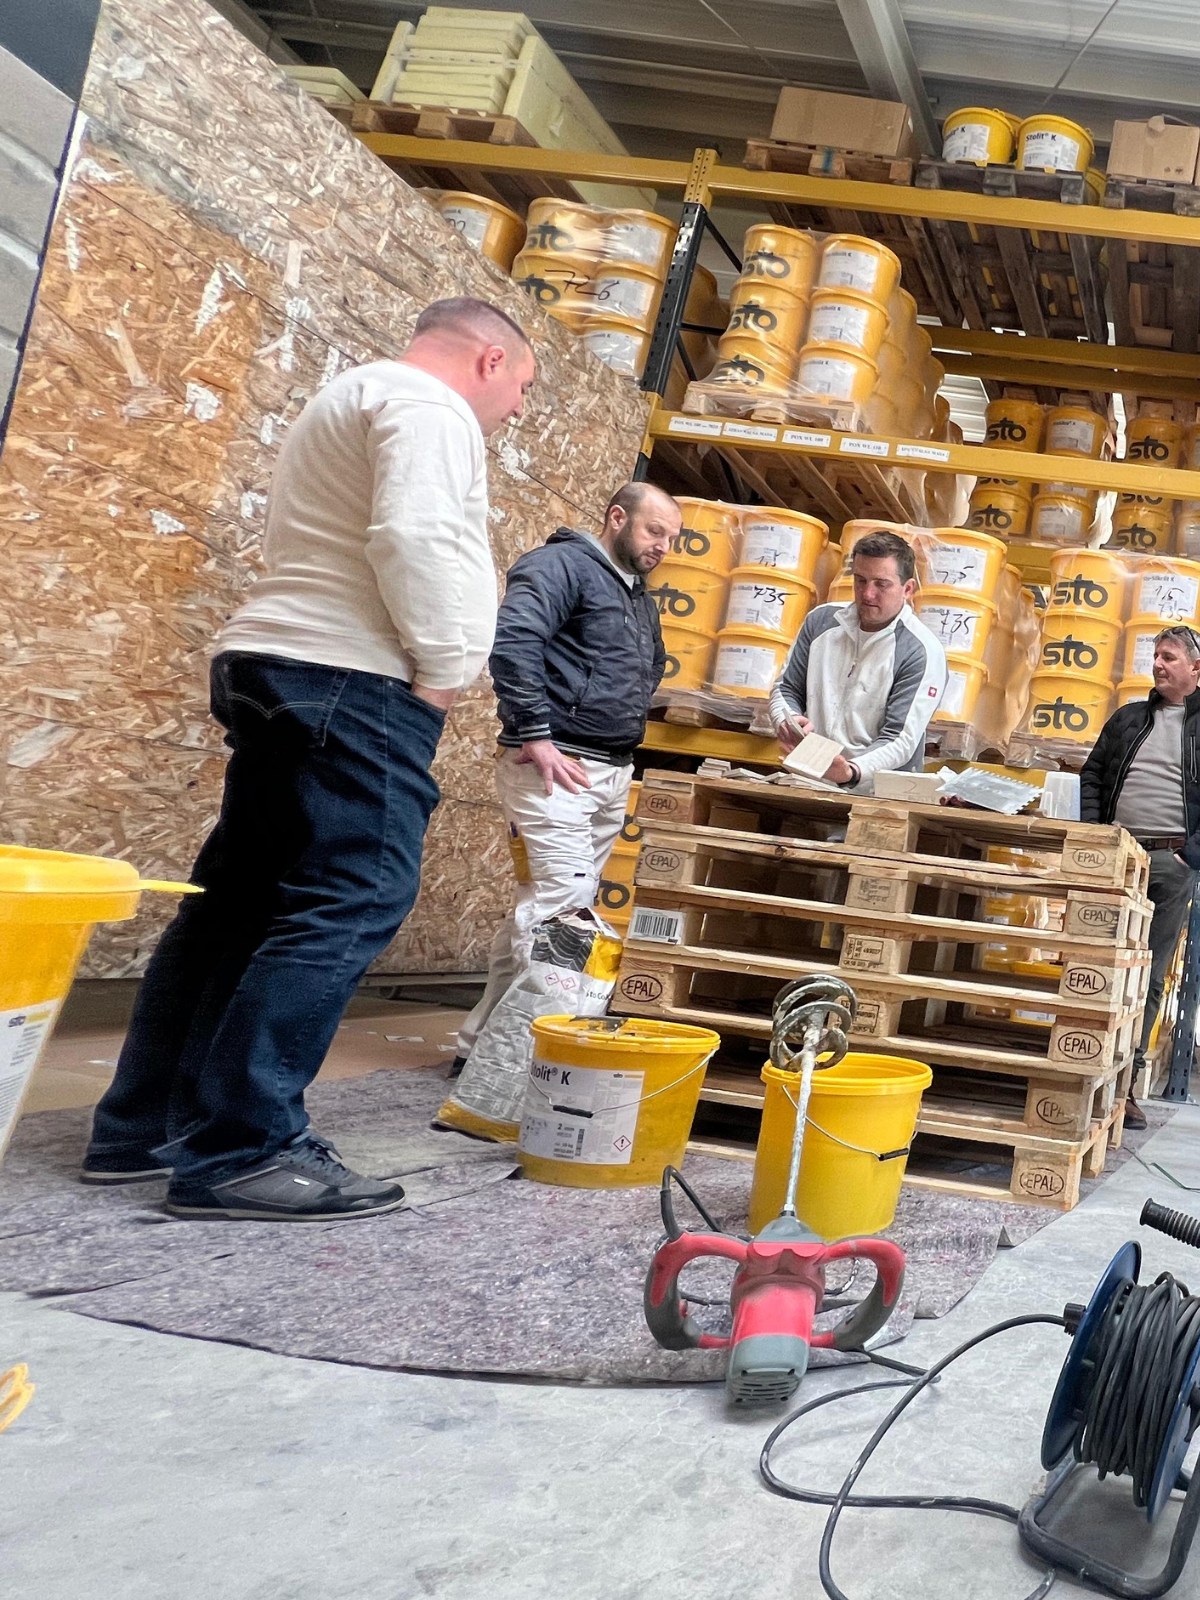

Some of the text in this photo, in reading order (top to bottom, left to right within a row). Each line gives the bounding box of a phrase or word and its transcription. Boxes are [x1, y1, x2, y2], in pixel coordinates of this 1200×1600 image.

[516, 274, 561, 305] to
[987, 417, 1026, 442] sto
[1129, 435, 1169, 461] sto
[971, 504, 1012, 529] sto
[674, 526, 711, 557] to
[1117, 523, 1157, 548] sto
[652, 583, 696, 617] to
[754, 585, 799, 605] 735
[1053, 573, 1108, 608] sto
[940, 609, 982, 635] 735
[1043, 633, 1099, 670] sto
[1033, 696, 1089, 732] sto
[650, 797, 673, 811] EPAL
[651, 855, 676, 868] EPAL
[1077, 851, 1104, 864] EPAL
[1082, 909, 1110, 923] EPAL
[626, 980, 656, 998] EPAL
[1069, 973, 1099, 991] EPAL
[1063, 1037, 1095, 1055] EPAL
[561, 1071, 572, 1086] K
[1043, 1101, 1065, 1117] EPA
[1026, 1174, 1057, 1192] EPAL
